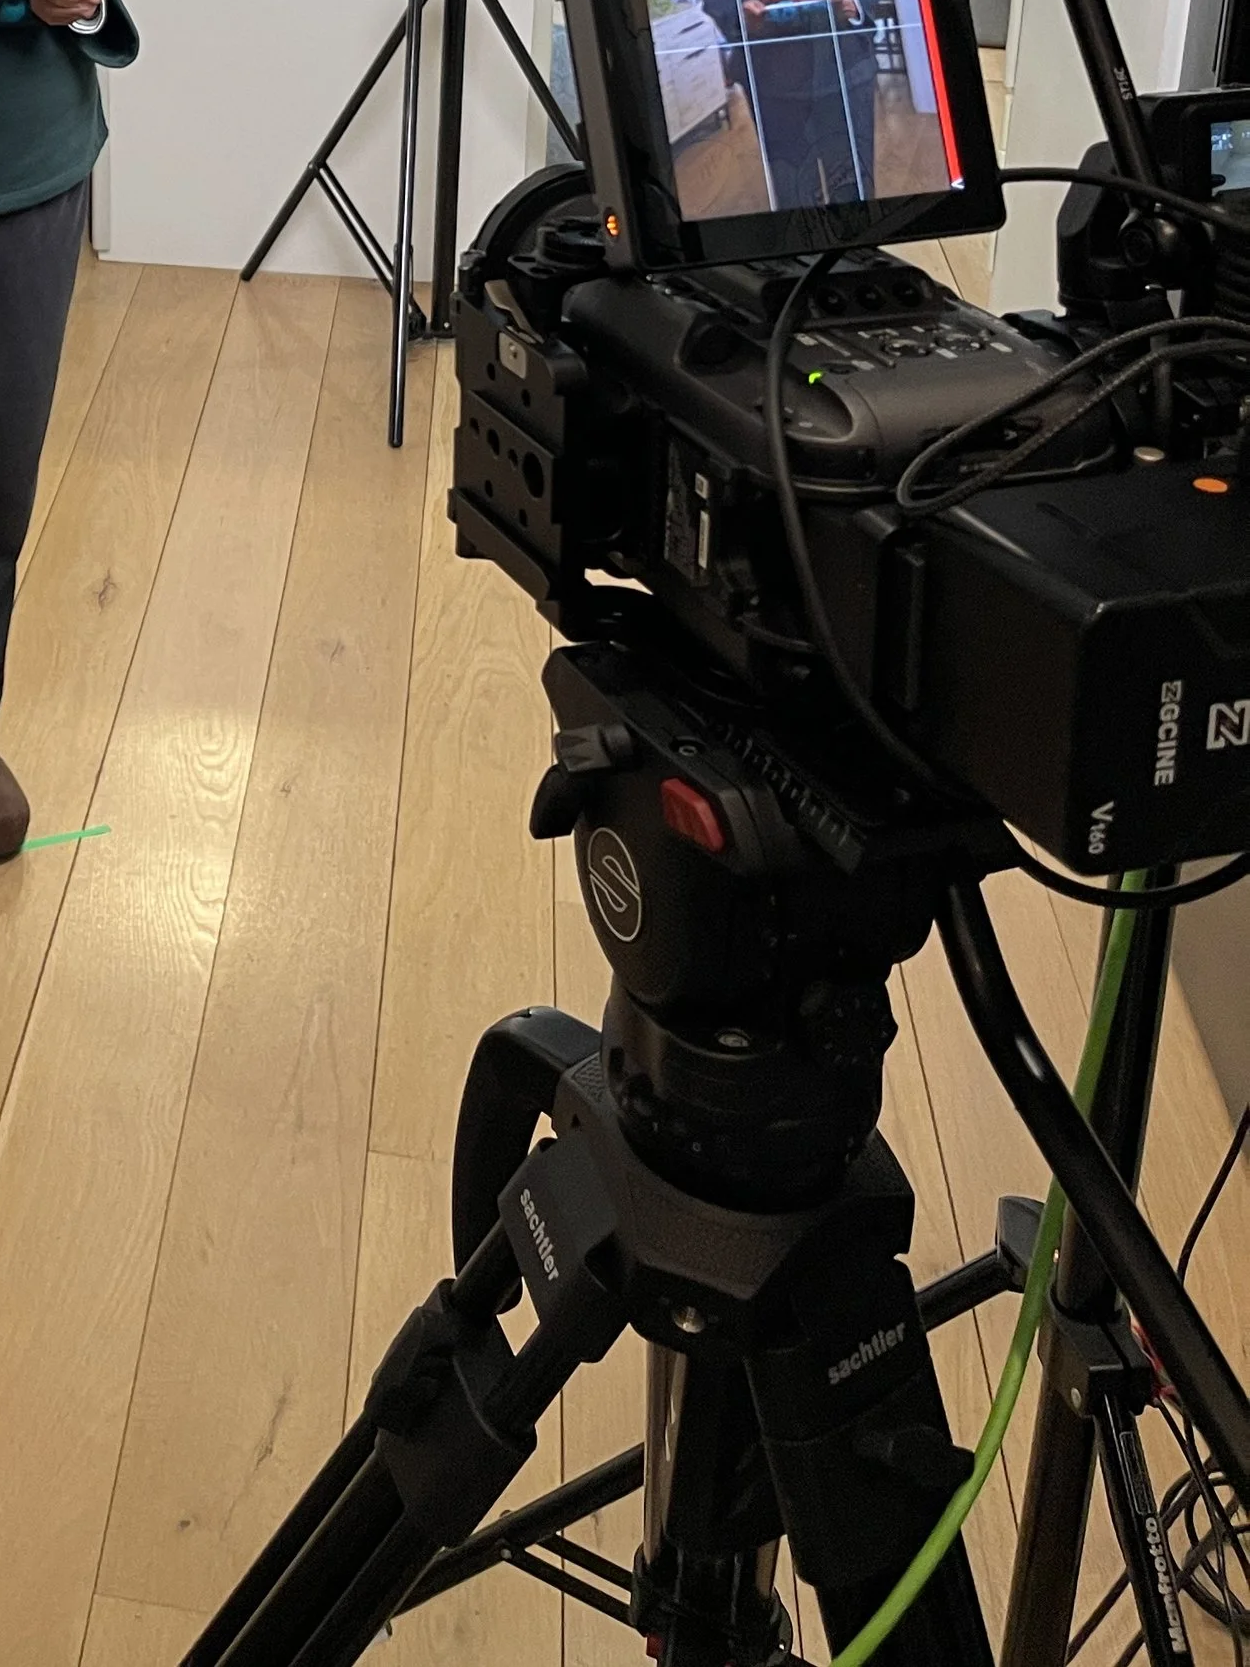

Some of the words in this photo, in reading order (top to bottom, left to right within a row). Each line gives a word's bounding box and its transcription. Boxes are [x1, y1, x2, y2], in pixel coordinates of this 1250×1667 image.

[1088, 800, 1115, 855] V160
[520, 1188, 560, 1281] sachtler
[828, 1322, 905, 1385] sachtler
[1145, 1516, 1187, 1653] Manfrotto
